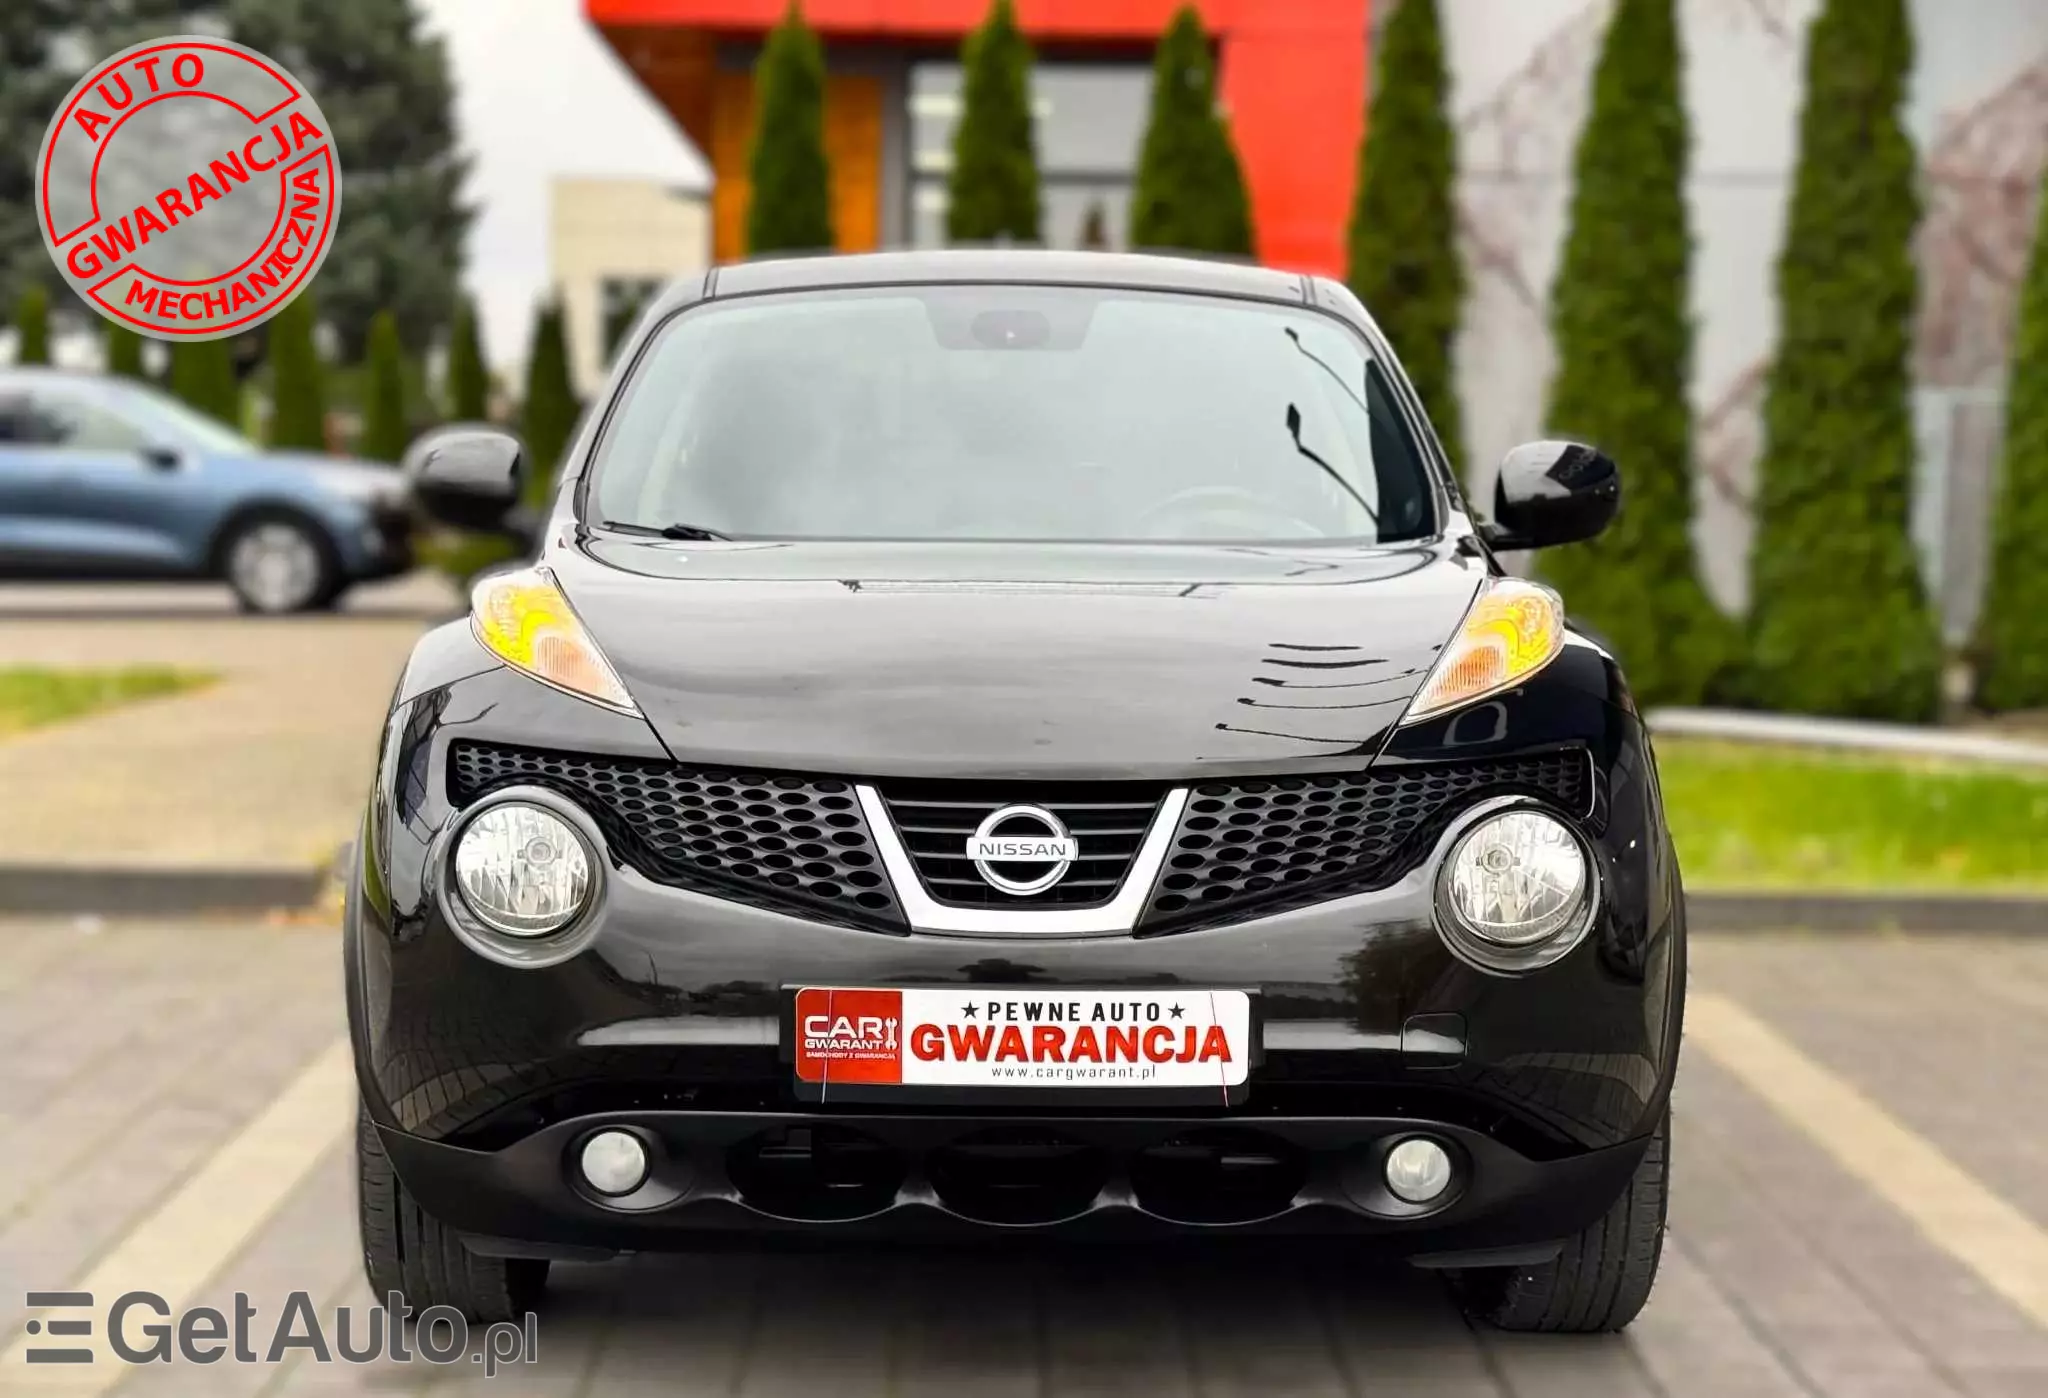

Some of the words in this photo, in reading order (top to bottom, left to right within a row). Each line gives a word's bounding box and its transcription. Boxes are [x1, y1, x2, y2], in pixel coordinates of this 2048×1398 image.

[979, 843, 1066, 856] NISSAN
[987, 1002, 1080, 1021] PEWNE
[1091, 1002, 1160, 1022] AUTO
[804, 1015, 883, 1039] CAR
[804, 1038, 883, 1050] GWARANT
[910, 1023, 1232, 1063] GWARANCJA
[991, 1064, 1156, 1081] www.cargwarant.pl
